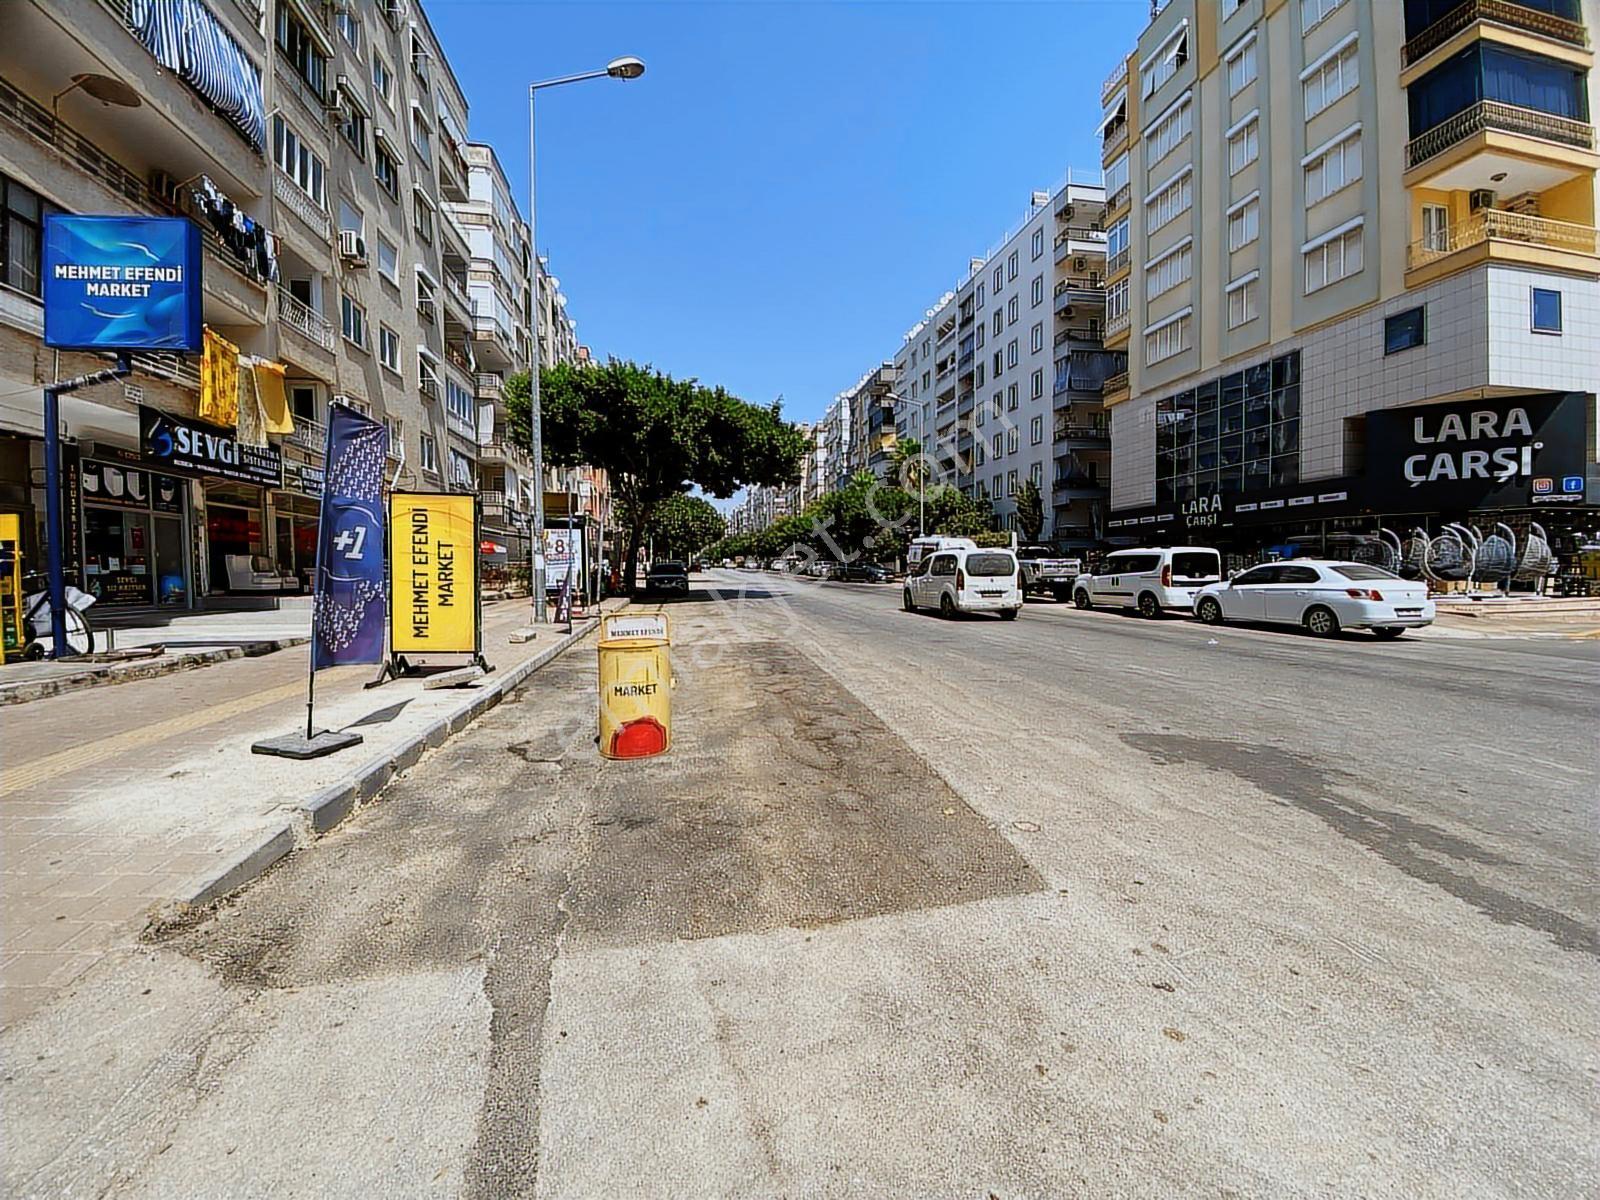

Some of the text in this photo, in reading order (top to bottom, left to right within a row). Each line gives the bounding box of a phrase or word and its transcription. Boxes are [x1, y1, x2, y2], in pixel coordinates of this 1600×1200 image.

[55, 264, 182, 282] MEHMET EFENDİ
[87, 284, 151, 297] MARKET
[1414, 407, 1534, 443] LARA
[1182, 494, 1222, 515] LARA
[333, 526, 365, 560] +1
[555, 539, 565, 553] 8
[437, 540, 454, 608] MARKET
[413, 574, 430, 638] MEHMET
[614, 683, 658, 697] MARKET
